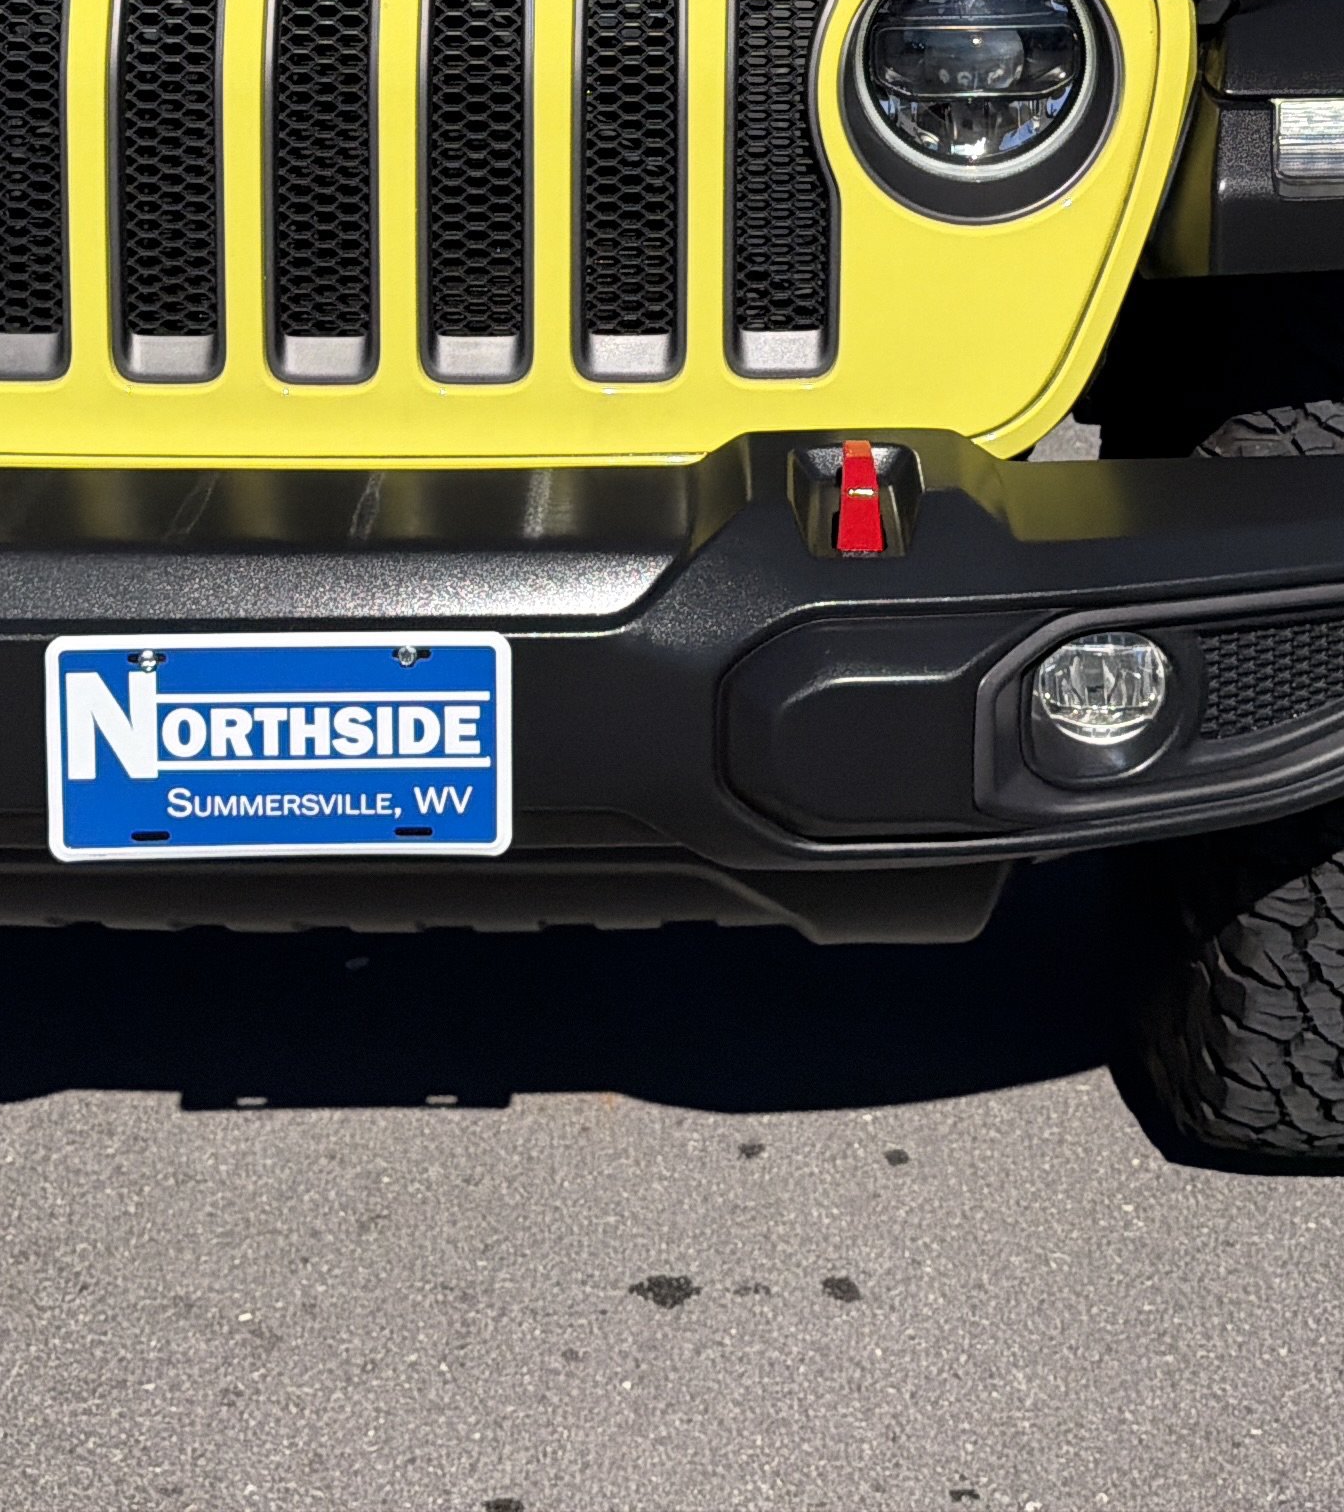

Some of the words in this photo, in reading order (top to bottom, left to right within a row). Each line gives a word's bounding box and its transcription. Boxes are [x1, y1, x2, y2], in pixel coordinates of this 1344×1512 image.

[65, 670, 481, 780] NORTHSIDE
[167, 788, 402, 818] SUMMERSVILLE,
[414, 785, 473, 814] WV
